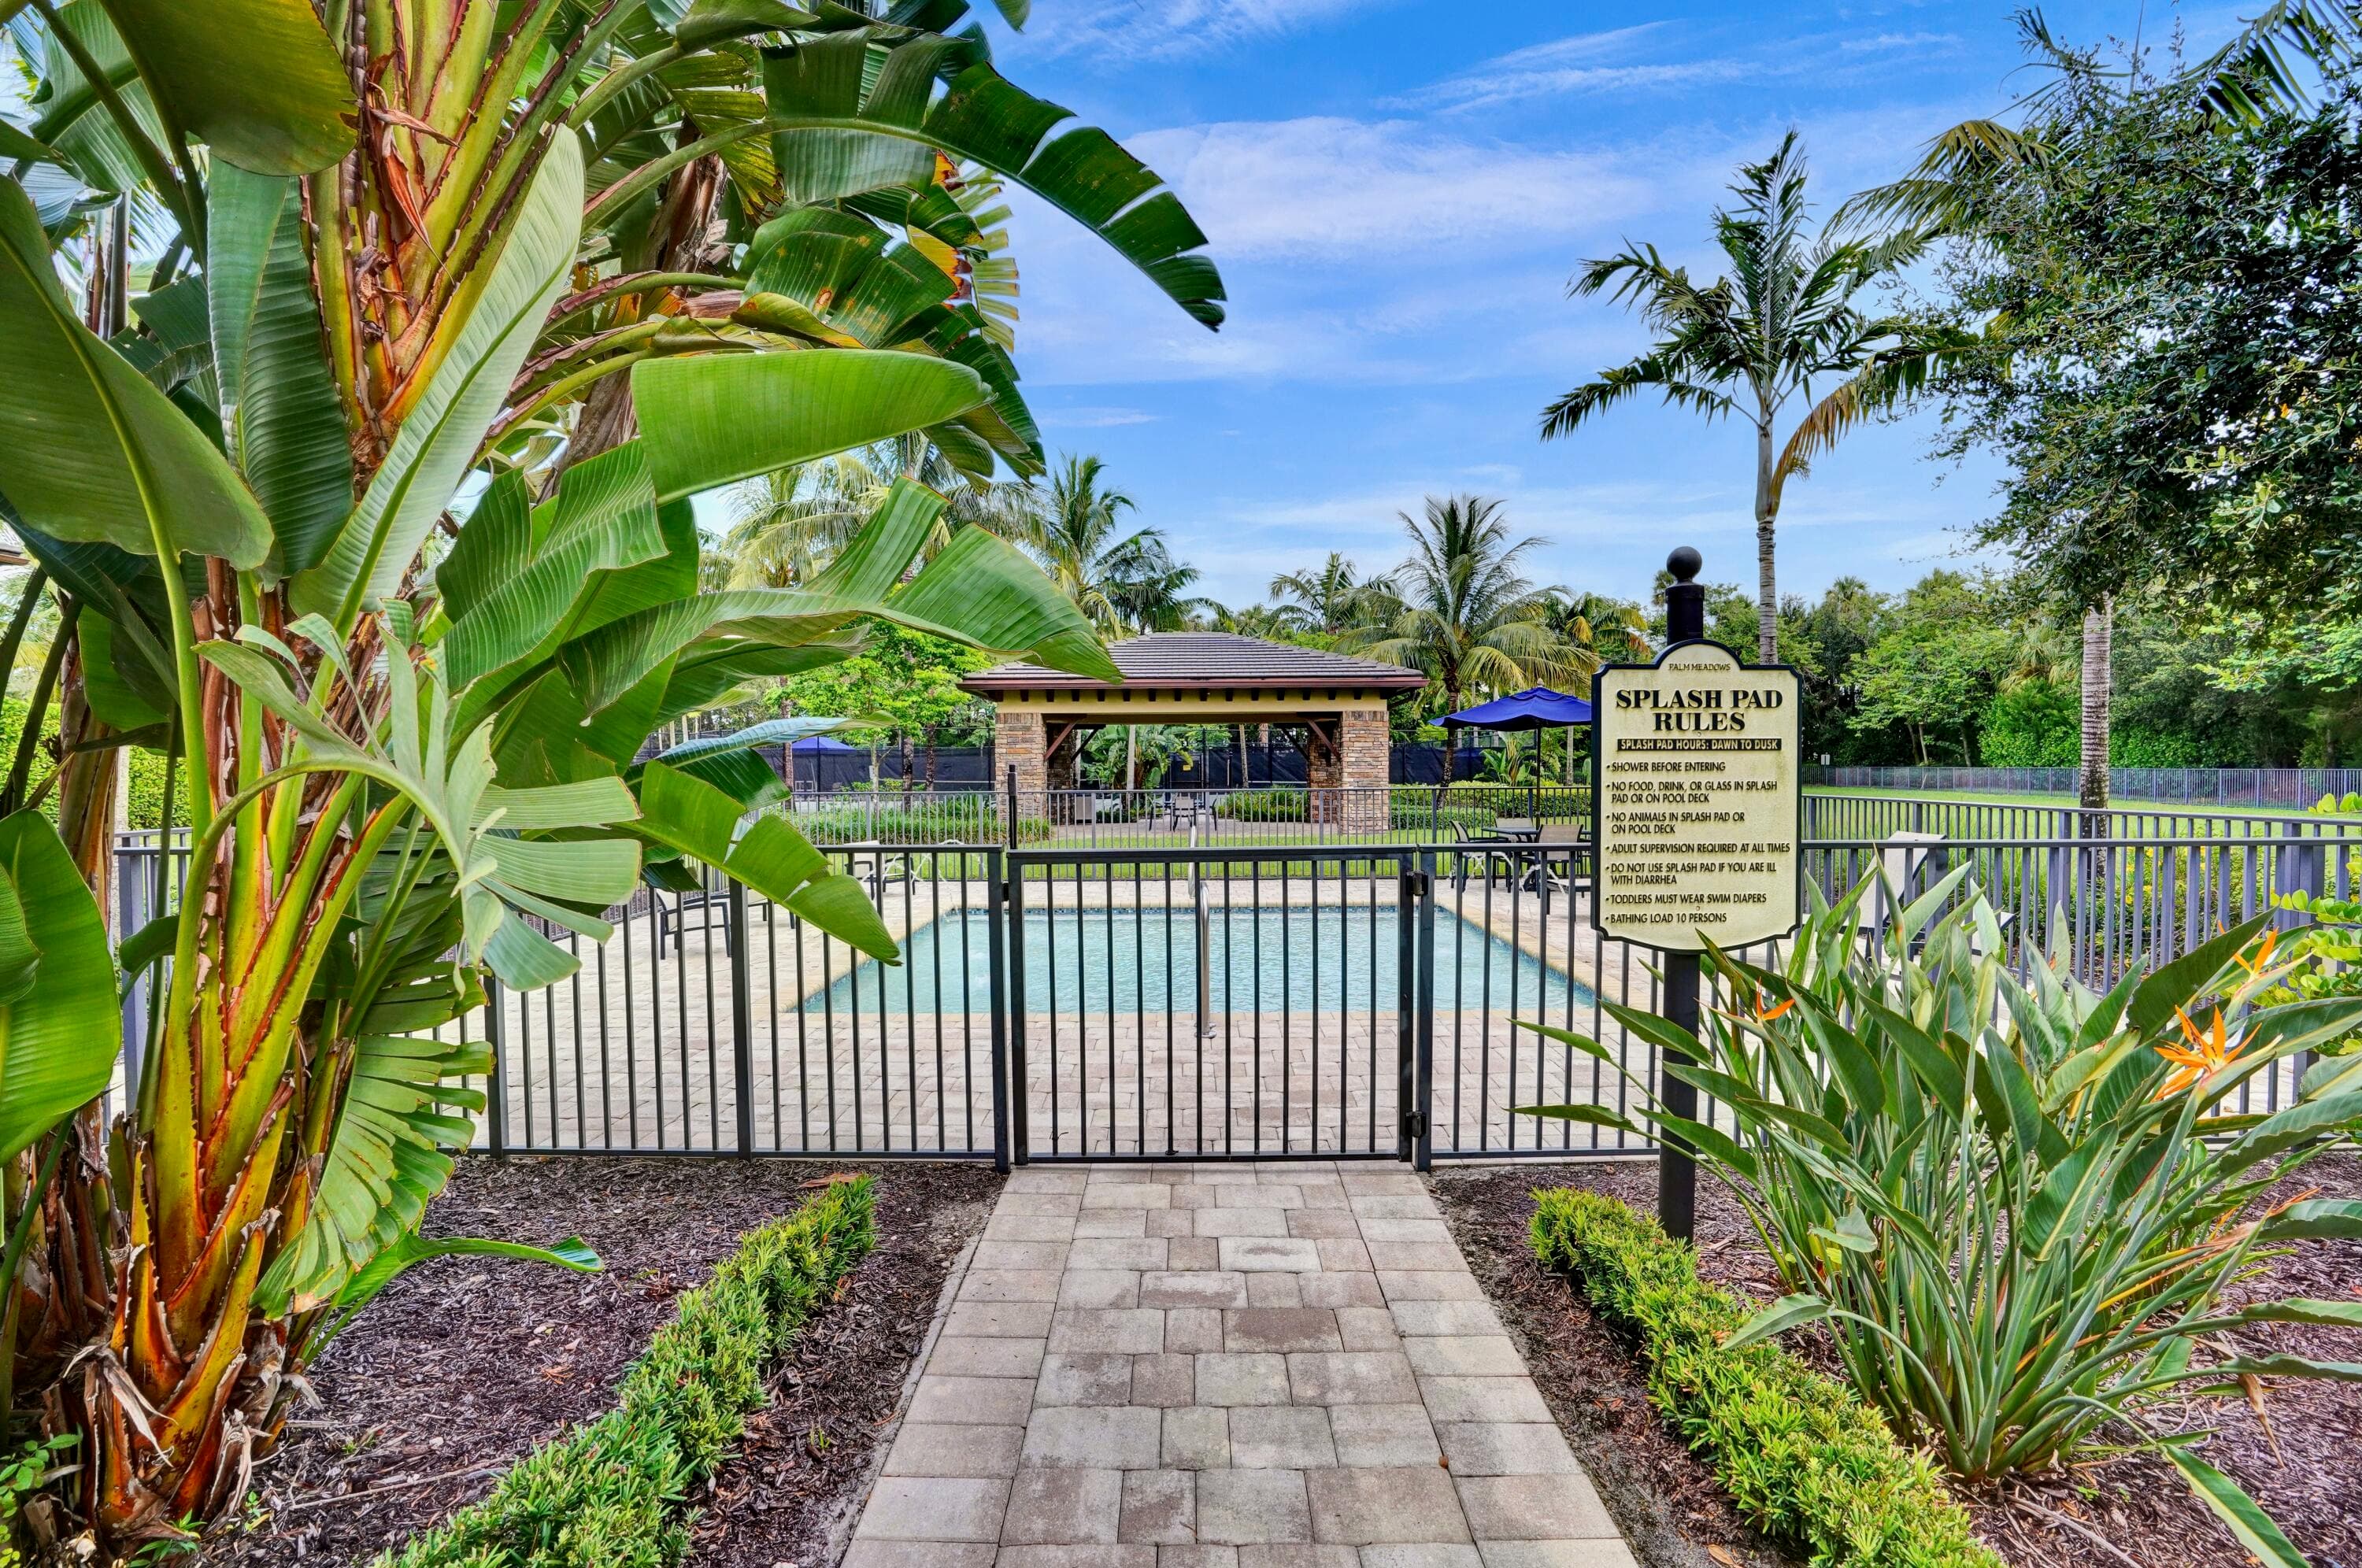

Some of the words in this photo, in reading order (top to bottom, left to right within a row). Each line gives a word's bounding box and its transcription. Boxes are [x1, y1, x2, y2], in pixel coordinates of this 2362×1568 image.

[1616, 690, 1722, 708] SPLASH
[1730, 690, 1783, 708] PAD
[1653, 712, 1745, 730] RULES
[1621, 741, 1653, 749] SPLASH
[1657, 741, 1674, 749] PAD
[1676, 741, 1709, 749] HOURS:
[1712, 740, 1738, 749] DAWN
[1741, 740, 1751, 749] TO
[1754, 740, 1777, 749] DUSK
[1612, 762, 1649, 771] SHOWER
[1652, 762, 1682, 771] BEFORE
[1685, 762, 1726, 771] ENTERING
[1612, 782, 1626, 791] NO
[1628, 782, 1656, 793] FOOD,
[1659, 782, 1686, 792] DRINK,
[1690, 782, 1702, 790] OR
[1705, 782, 1731, 790] GLASS
[1734, 781, 1743, 790] IN
[1746, 781, 1776, 790] SPLASH
[1612, 793, 1628, 803] PAD
[1631, 793, 1643, 803] OR
[1646, 793, 1660, 803] ON
[1663, 793, 1686, 802] POOL
[1689, 793, 1709, 802] DECK
[1612, 812, 1626, 822] NO
[1628, 812, 1666, 822] ANIMALS
[1669, 812, 1679, 822] IN
[1681, 812, 1711, 821] SPLASH
[1713, 812, 1730, 821] PAD
[1732, 812, 1745, 821] OR
[1612, 825, 1626, 834] ON
[1628, 825, 1651, 834] POOL
[1654, 824, 1675, 834] DECK
[1610, 844, 1637, 853] ADULT
[1640, 844, 1694, 853] SUPERVISION
[1697, 844, 1737, 853] REQUIRED
[1739, 843, 1749, 852] AT
[1752, 843, 1765, 852] ALL
[1767, 843, 1790, 852] TIMES
[1611, 864, 1624, 873] DO
[1627, 864, 1646, 872] NOT
[1649, 864, 1664, 872] USE
[1666, 863, 1697, 872] SPLASH
[1700, 863, 1716, 872] PAD
[1719, 863, 1725, 871] IF
[1727, 863, 1746, 871] YOU
[1749, 863, 1764, 871] ARE
[1767, 863, 1776, 871] ILL
[1611, 875, 1633, 885] WITH
[1635, 875, 1676, 885] DIARRHEA
[1611, 894, 1652, 904] TODDLERS
[1655, 894, 1677, 904] MUST
[1679, 894, 1704, 904] WEAR
[1707, 894, 1731, 903] SWIM
[1734, 893, 1767, 903] DIAPERS
[1611, 914, 1647, 923] BATHING
[1650, 914, 1673, 923] LOAD
[1676, 913, 1686, 923] 10
[1689, 913, 1727, 923] PERSONS
